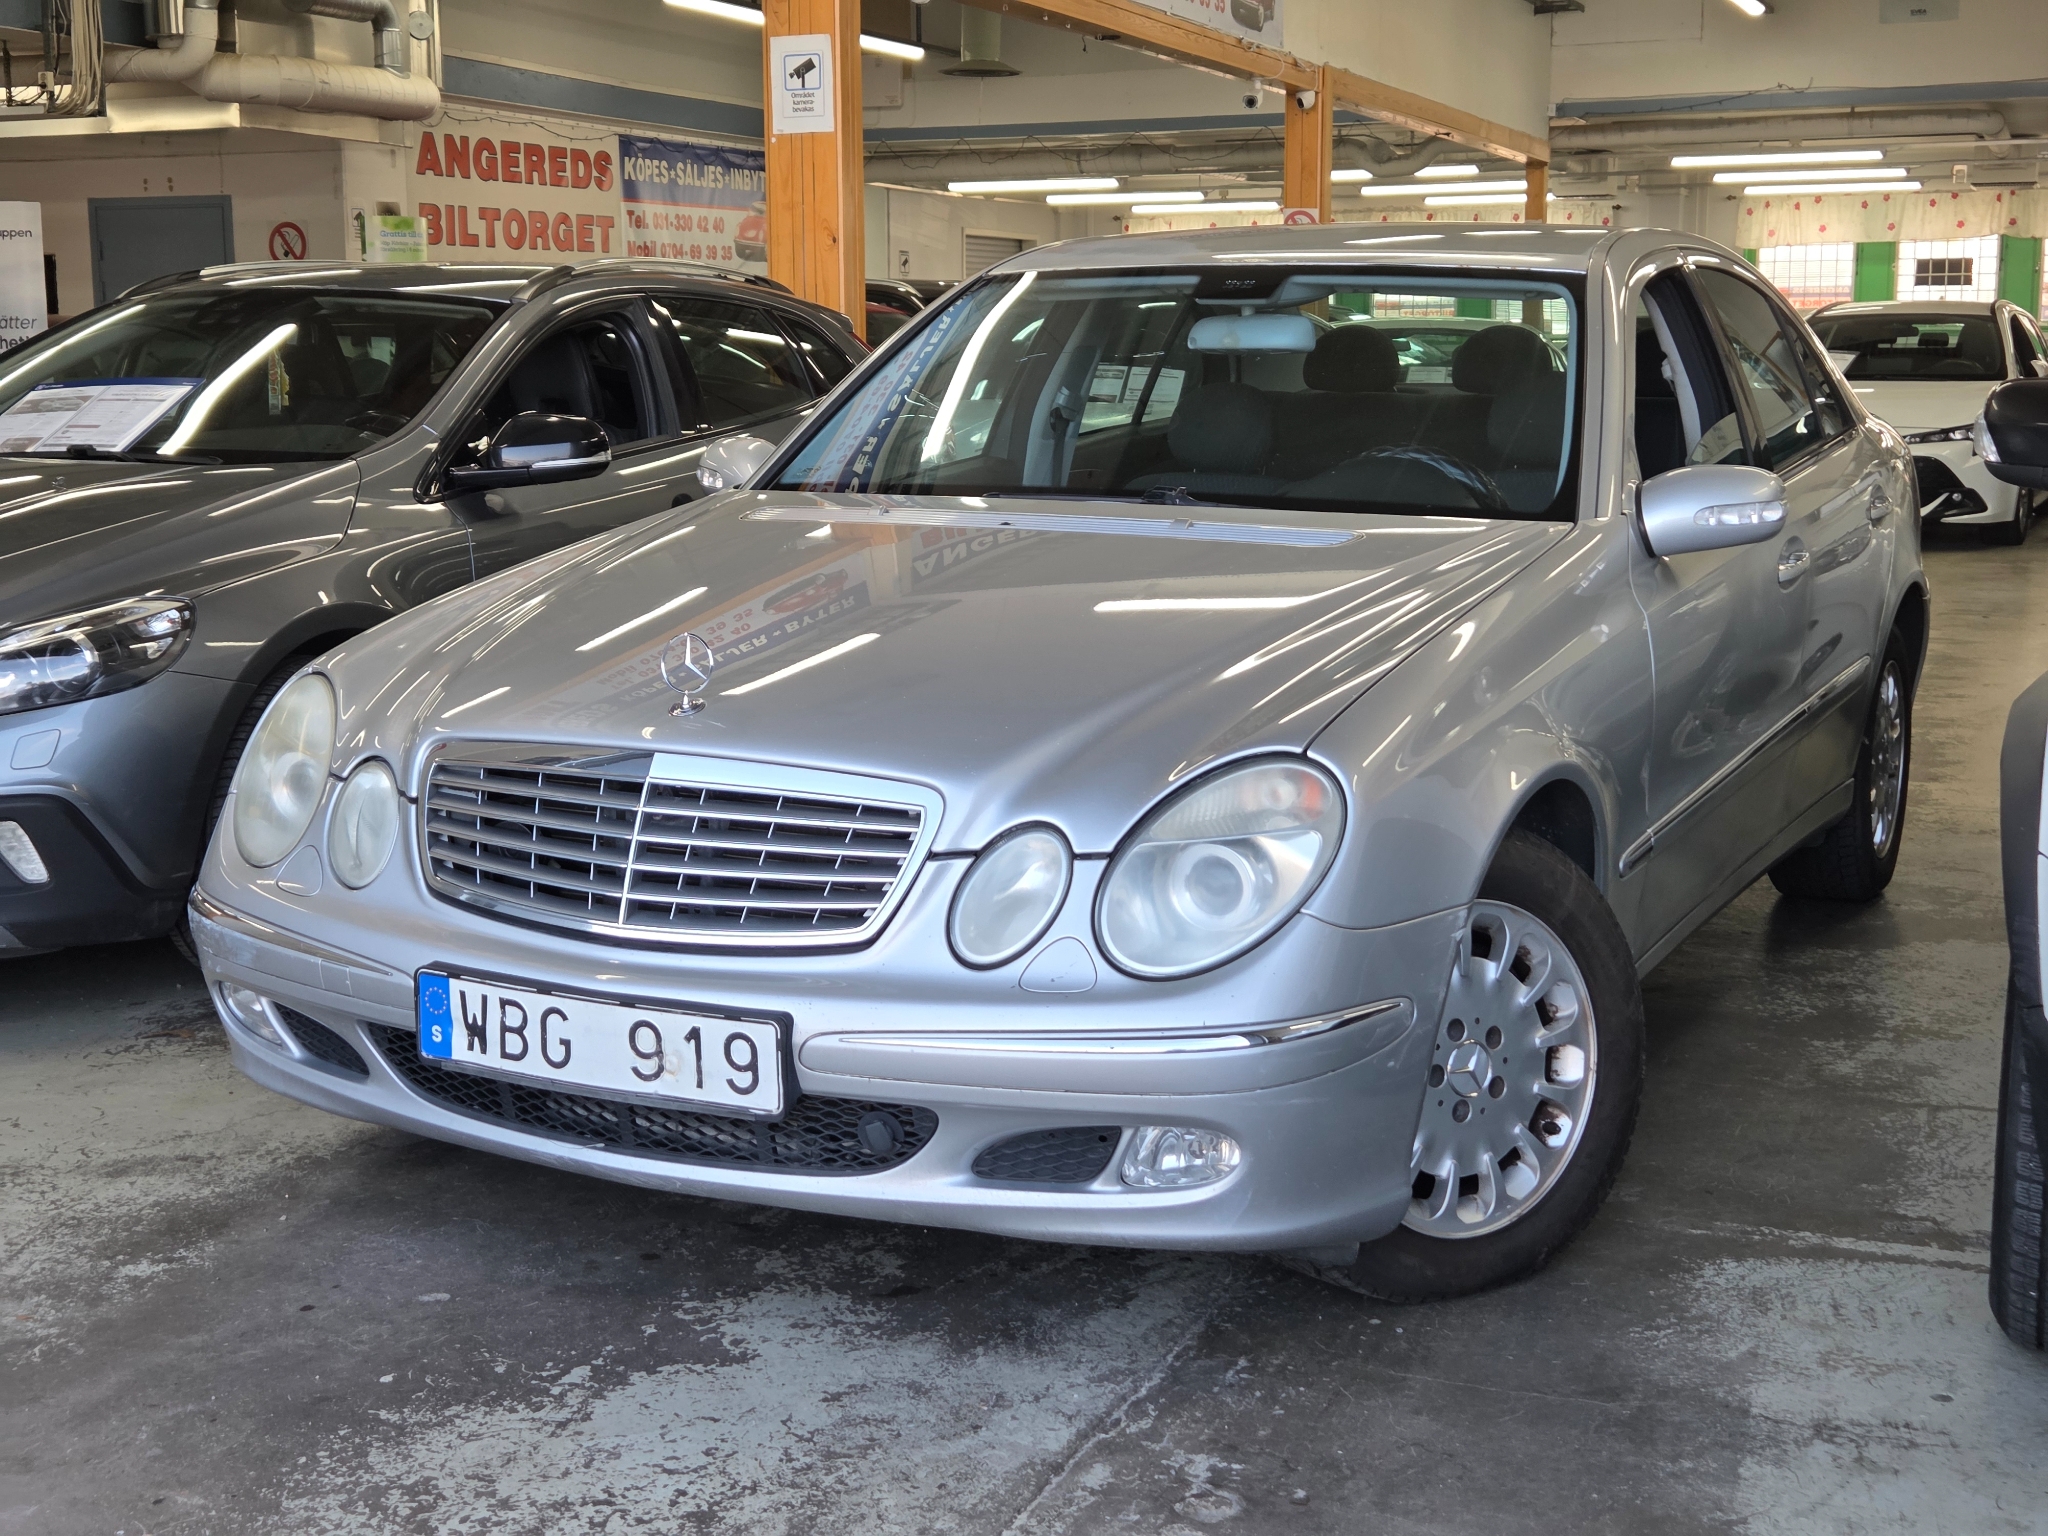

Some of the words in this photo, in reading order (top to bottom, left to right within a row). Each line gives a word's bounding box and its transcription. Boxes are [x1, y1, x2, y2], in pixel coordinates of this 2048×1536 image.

[791, 91, 815, 99] Området
[416, 131, 613, 192] ANGEREDS
[624, 153, 669, 184] KÖPES
[676, 159, 724, 189] SÄLJES
[419, 203, 614, 253] BILTORGET
[627, 210, 649, 229] Tel.
[653, 212, 692, 232] 031-330
[697, 215, 709, 232] 42
[713, 217, 725, 234] 40
[0, 229, 33, 240] ppen
[627, 240, 656, 257] Mobil
[660, 242, 702, 260] 0704-69
[706, 244, 718, 260] 39
[721, 245, 732, 260] 35
[431, 1024, 442, 1043] S
[459, 989, 572, 1069] WBG
[628, 1018, 760, 1096] 919
